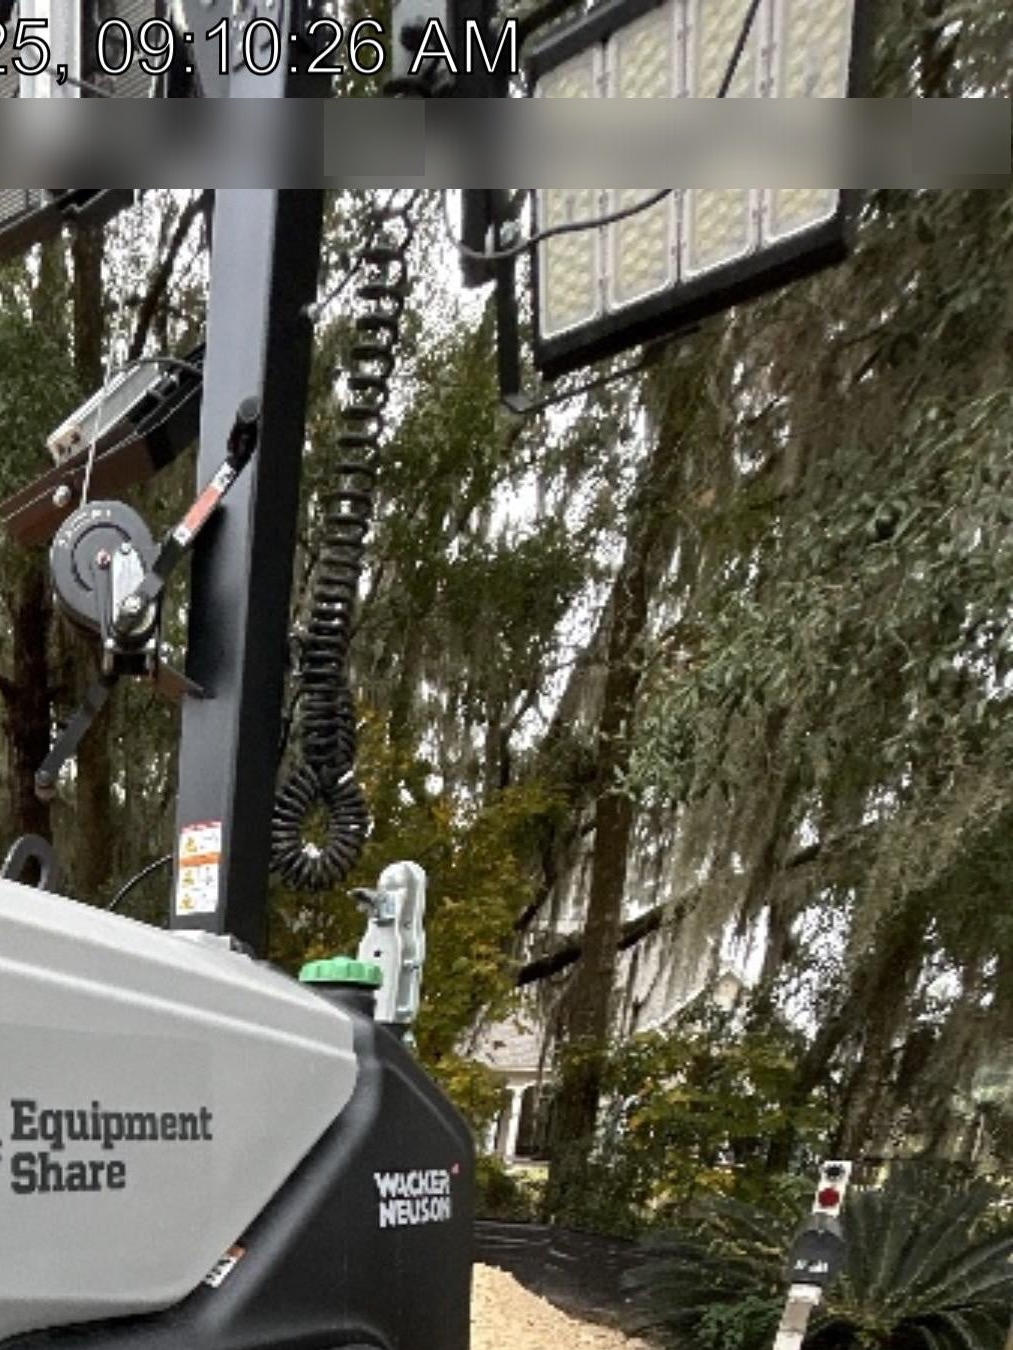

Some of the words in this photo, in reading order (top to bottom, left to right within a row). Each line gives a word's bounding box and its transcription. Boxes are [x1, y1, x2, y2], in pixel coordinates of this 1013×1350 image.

[11, 1098, 213, 1150] Equipment
[11, 1151, 126, 1194] Share
[374, 1169, 450, 1198] WACKER
[380, 1197, 450, 1228] NEUSON
